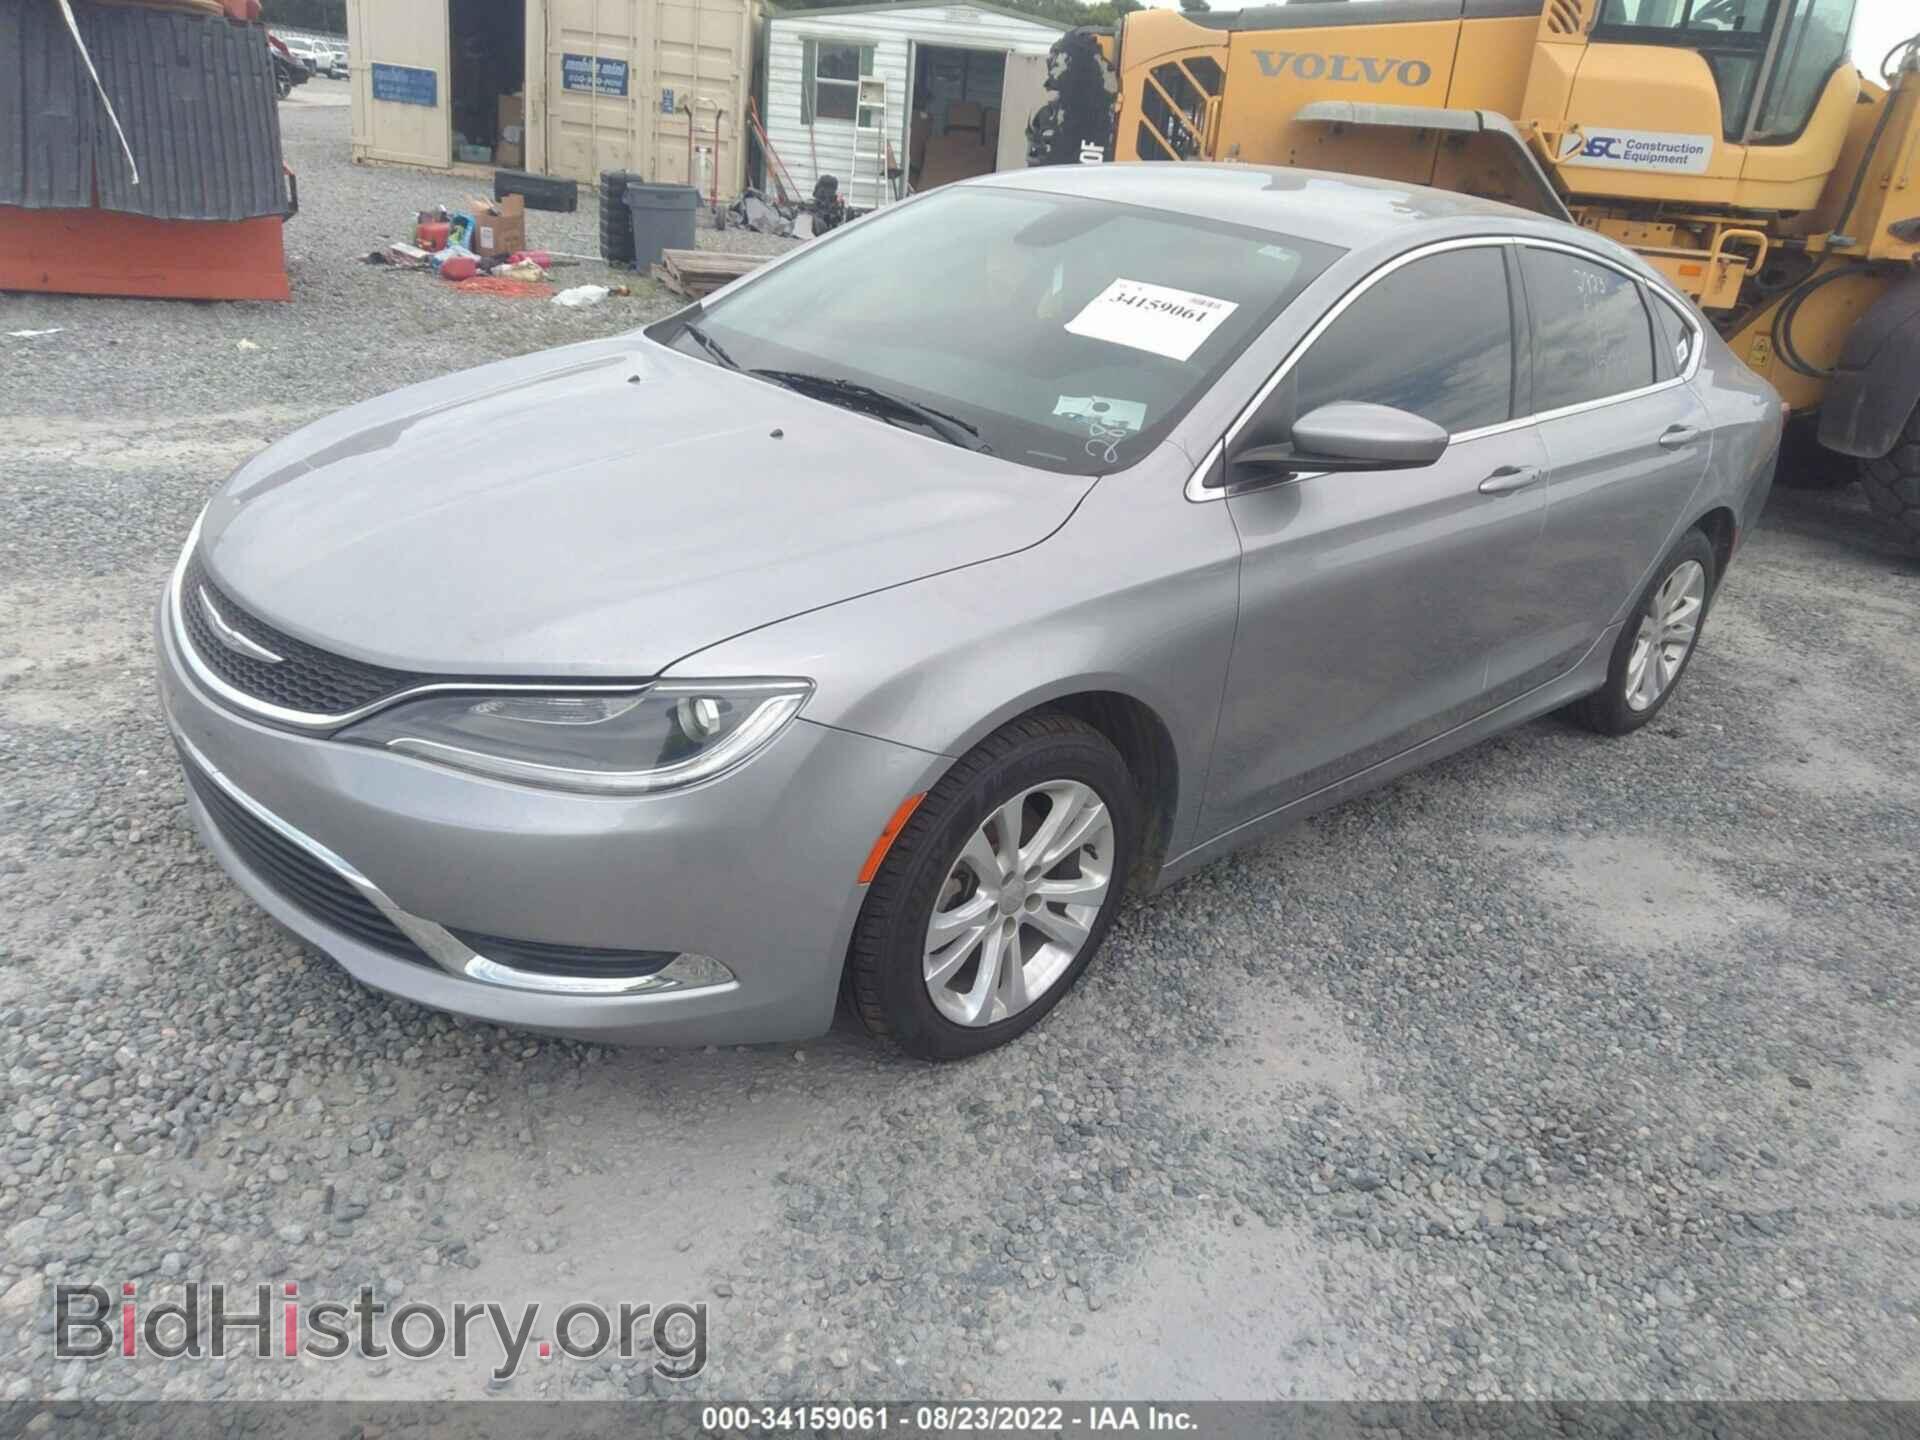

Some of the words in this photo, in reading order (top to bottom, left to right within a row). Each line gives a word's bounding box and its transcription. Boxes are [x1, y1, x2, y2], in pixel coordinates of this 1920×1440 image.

[564, 57, 600, 73] mobie
[1250, 49, 1432, 86] VOLVO
[1626, 138, 1704, 154] Construction
[1623, 150, 1688, 165] Equipment
[1108, 292, 1209, 322] 34159061
